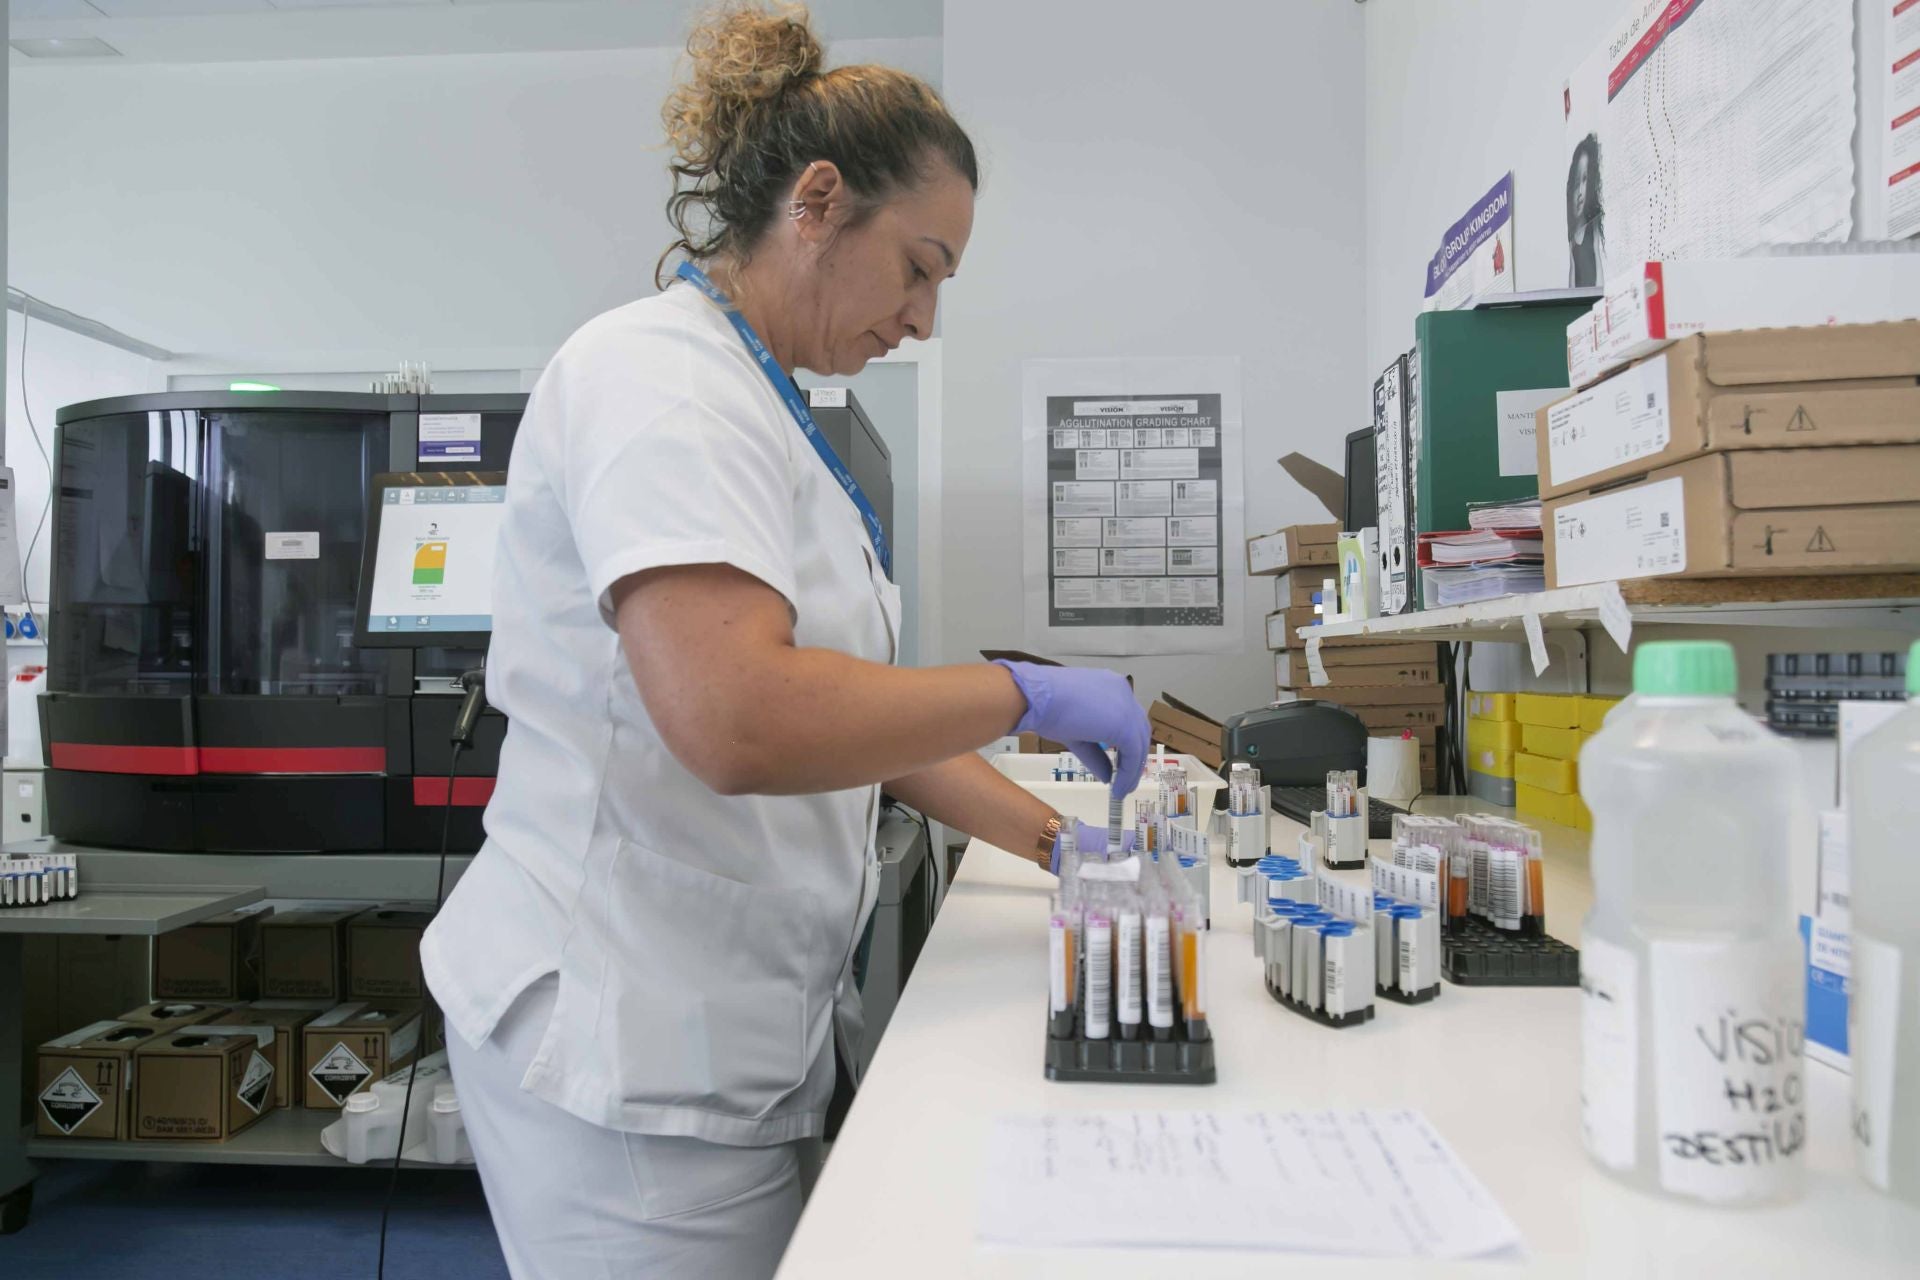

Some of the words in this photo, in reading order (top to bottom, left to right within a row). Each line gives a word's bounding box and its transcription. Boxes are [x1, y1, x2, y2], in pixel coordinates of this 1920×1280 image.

[1445, 227, 1471, 260] GROUP
[1470, 190, 1508, 236] KINGDOM
[1160, 405, 1184, 413] VISION
[1059, 417, 1133, 428] AGGLUTINATION
[1135, 417, 1178, 427] GRADING
[1180, 416, 1212, 427] CHART
